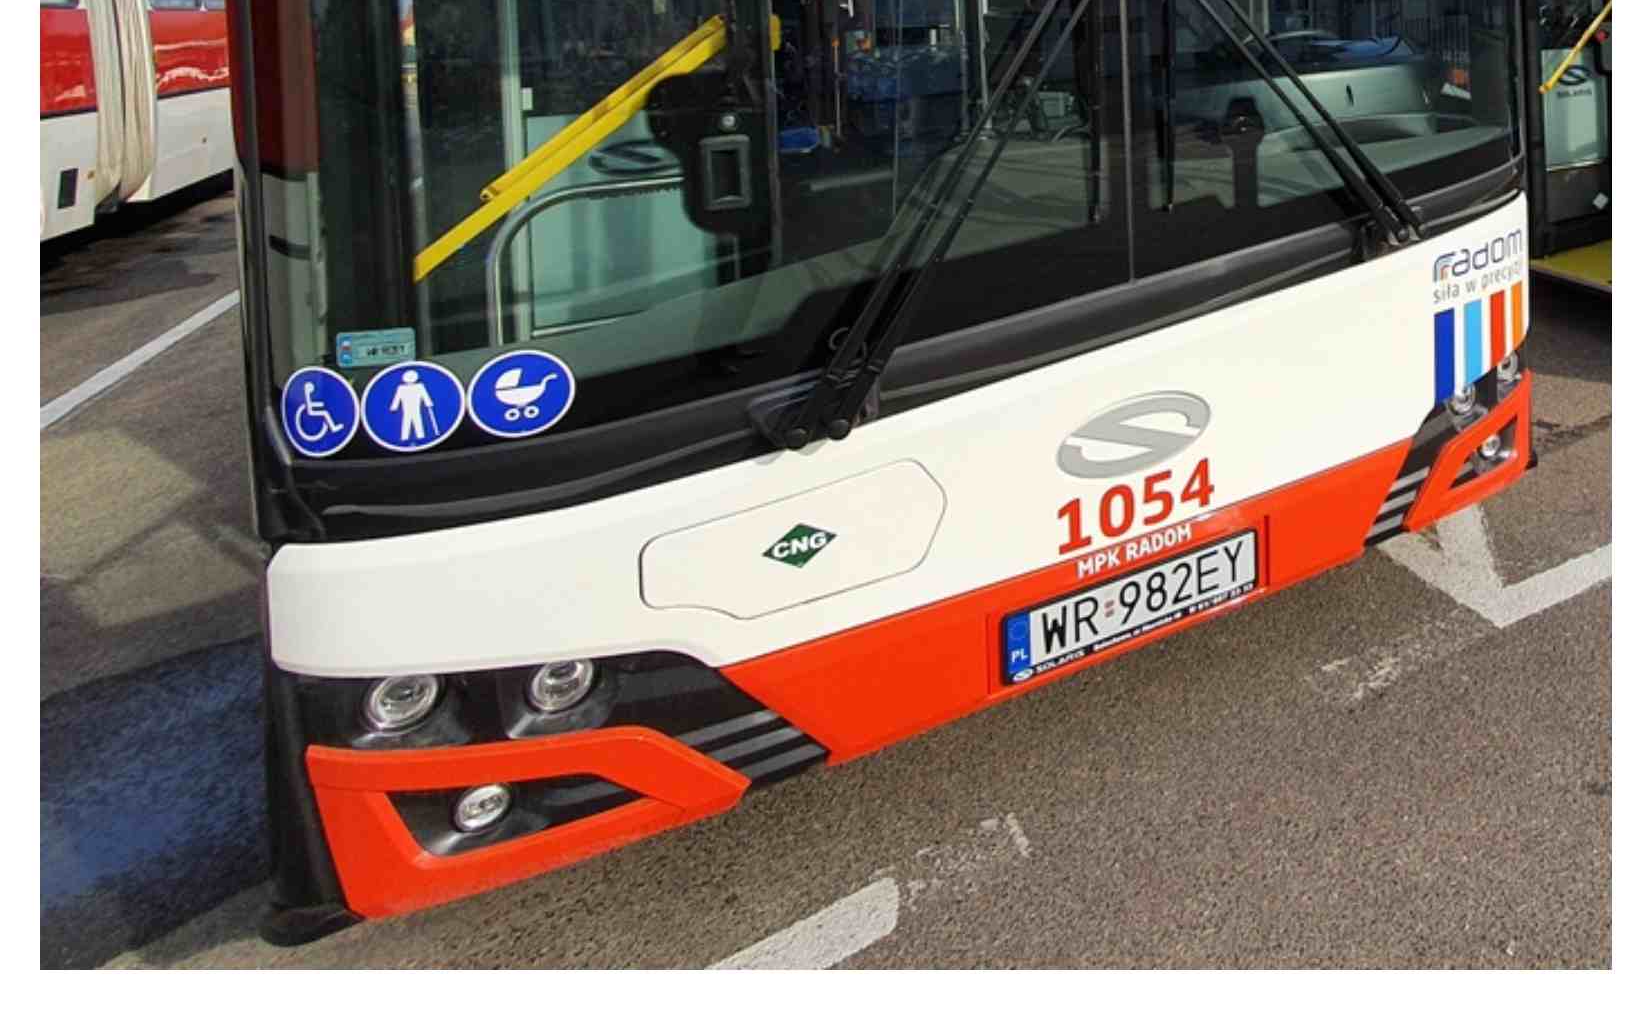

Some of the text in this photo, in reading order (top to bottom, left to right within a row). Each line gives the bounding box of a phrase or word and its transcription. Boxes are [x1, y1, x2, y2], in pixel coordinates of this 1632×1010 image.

[1433, 228, 1522, 283] radom
[1056, 456, 1216, 555] 1054
[773, 532, 827, 558] CNG
[1076, 522, 1192, 579] MPK RADOM
[1011, 648, 1028, 663] PL
